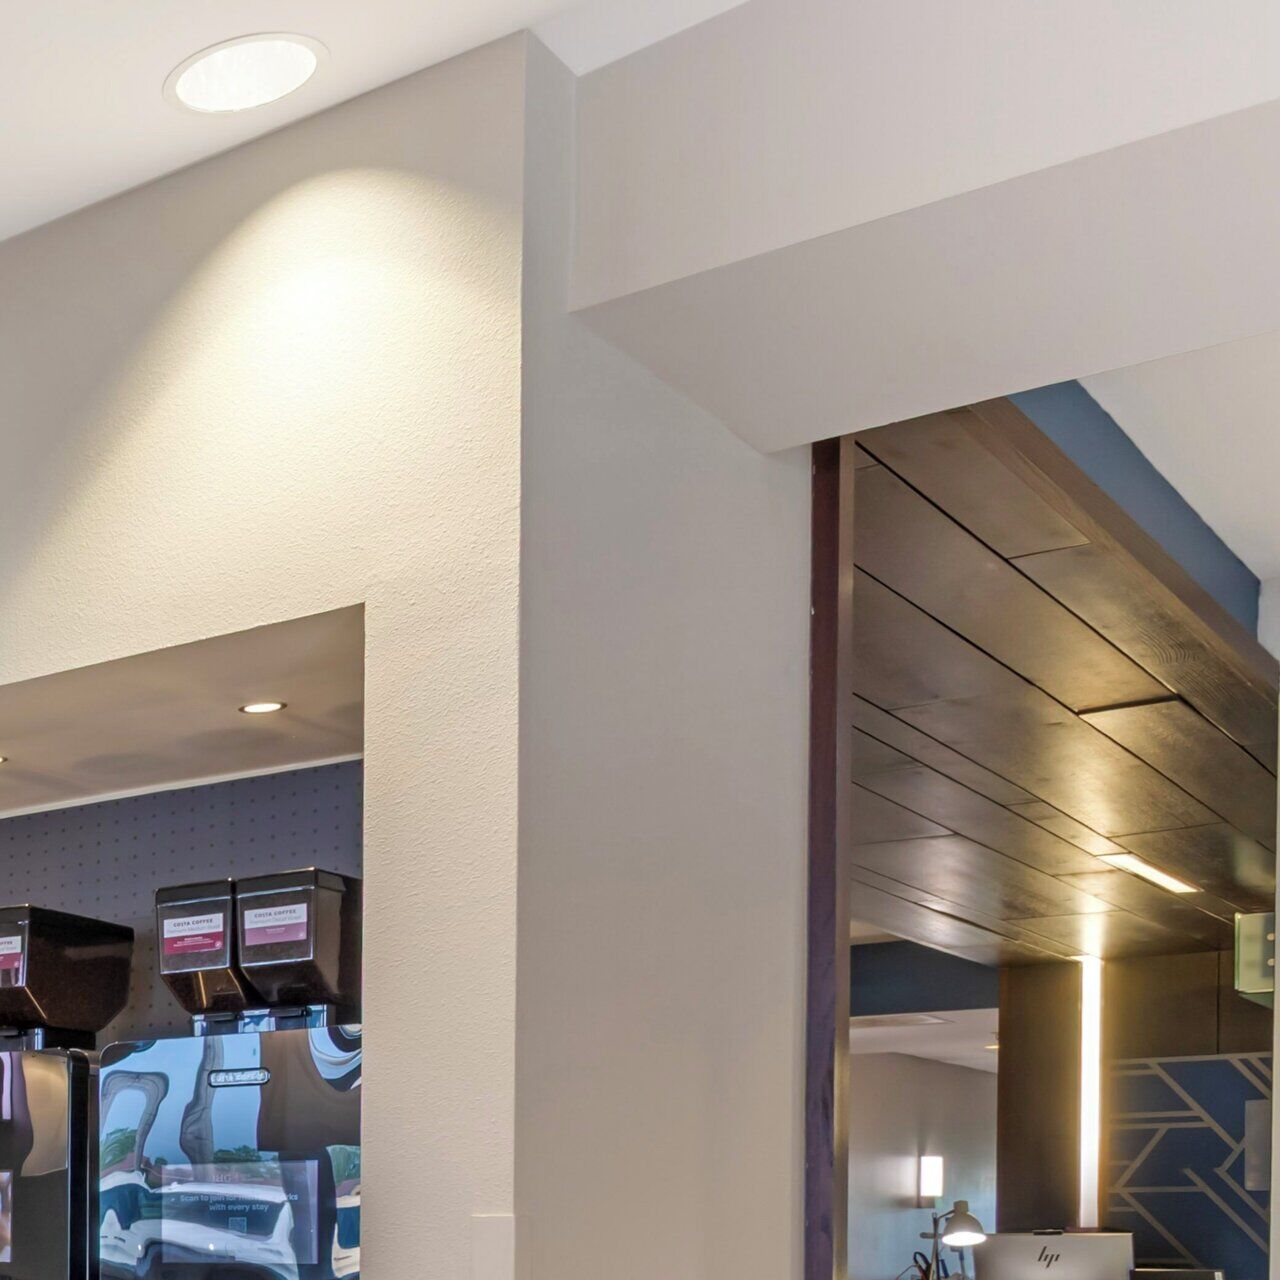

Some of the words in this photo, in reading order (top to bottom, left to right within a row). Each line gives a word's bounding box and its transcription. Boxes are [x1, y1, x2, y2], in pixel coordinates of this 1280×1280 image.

[173, 920, 190, 928] COSTA
[192, 917, 213, 925] COFFEE
[209, 1203, 226, 1211] with
[227, 1204, 249, 1212] every
[252, 1204, 269, 1212] stay
